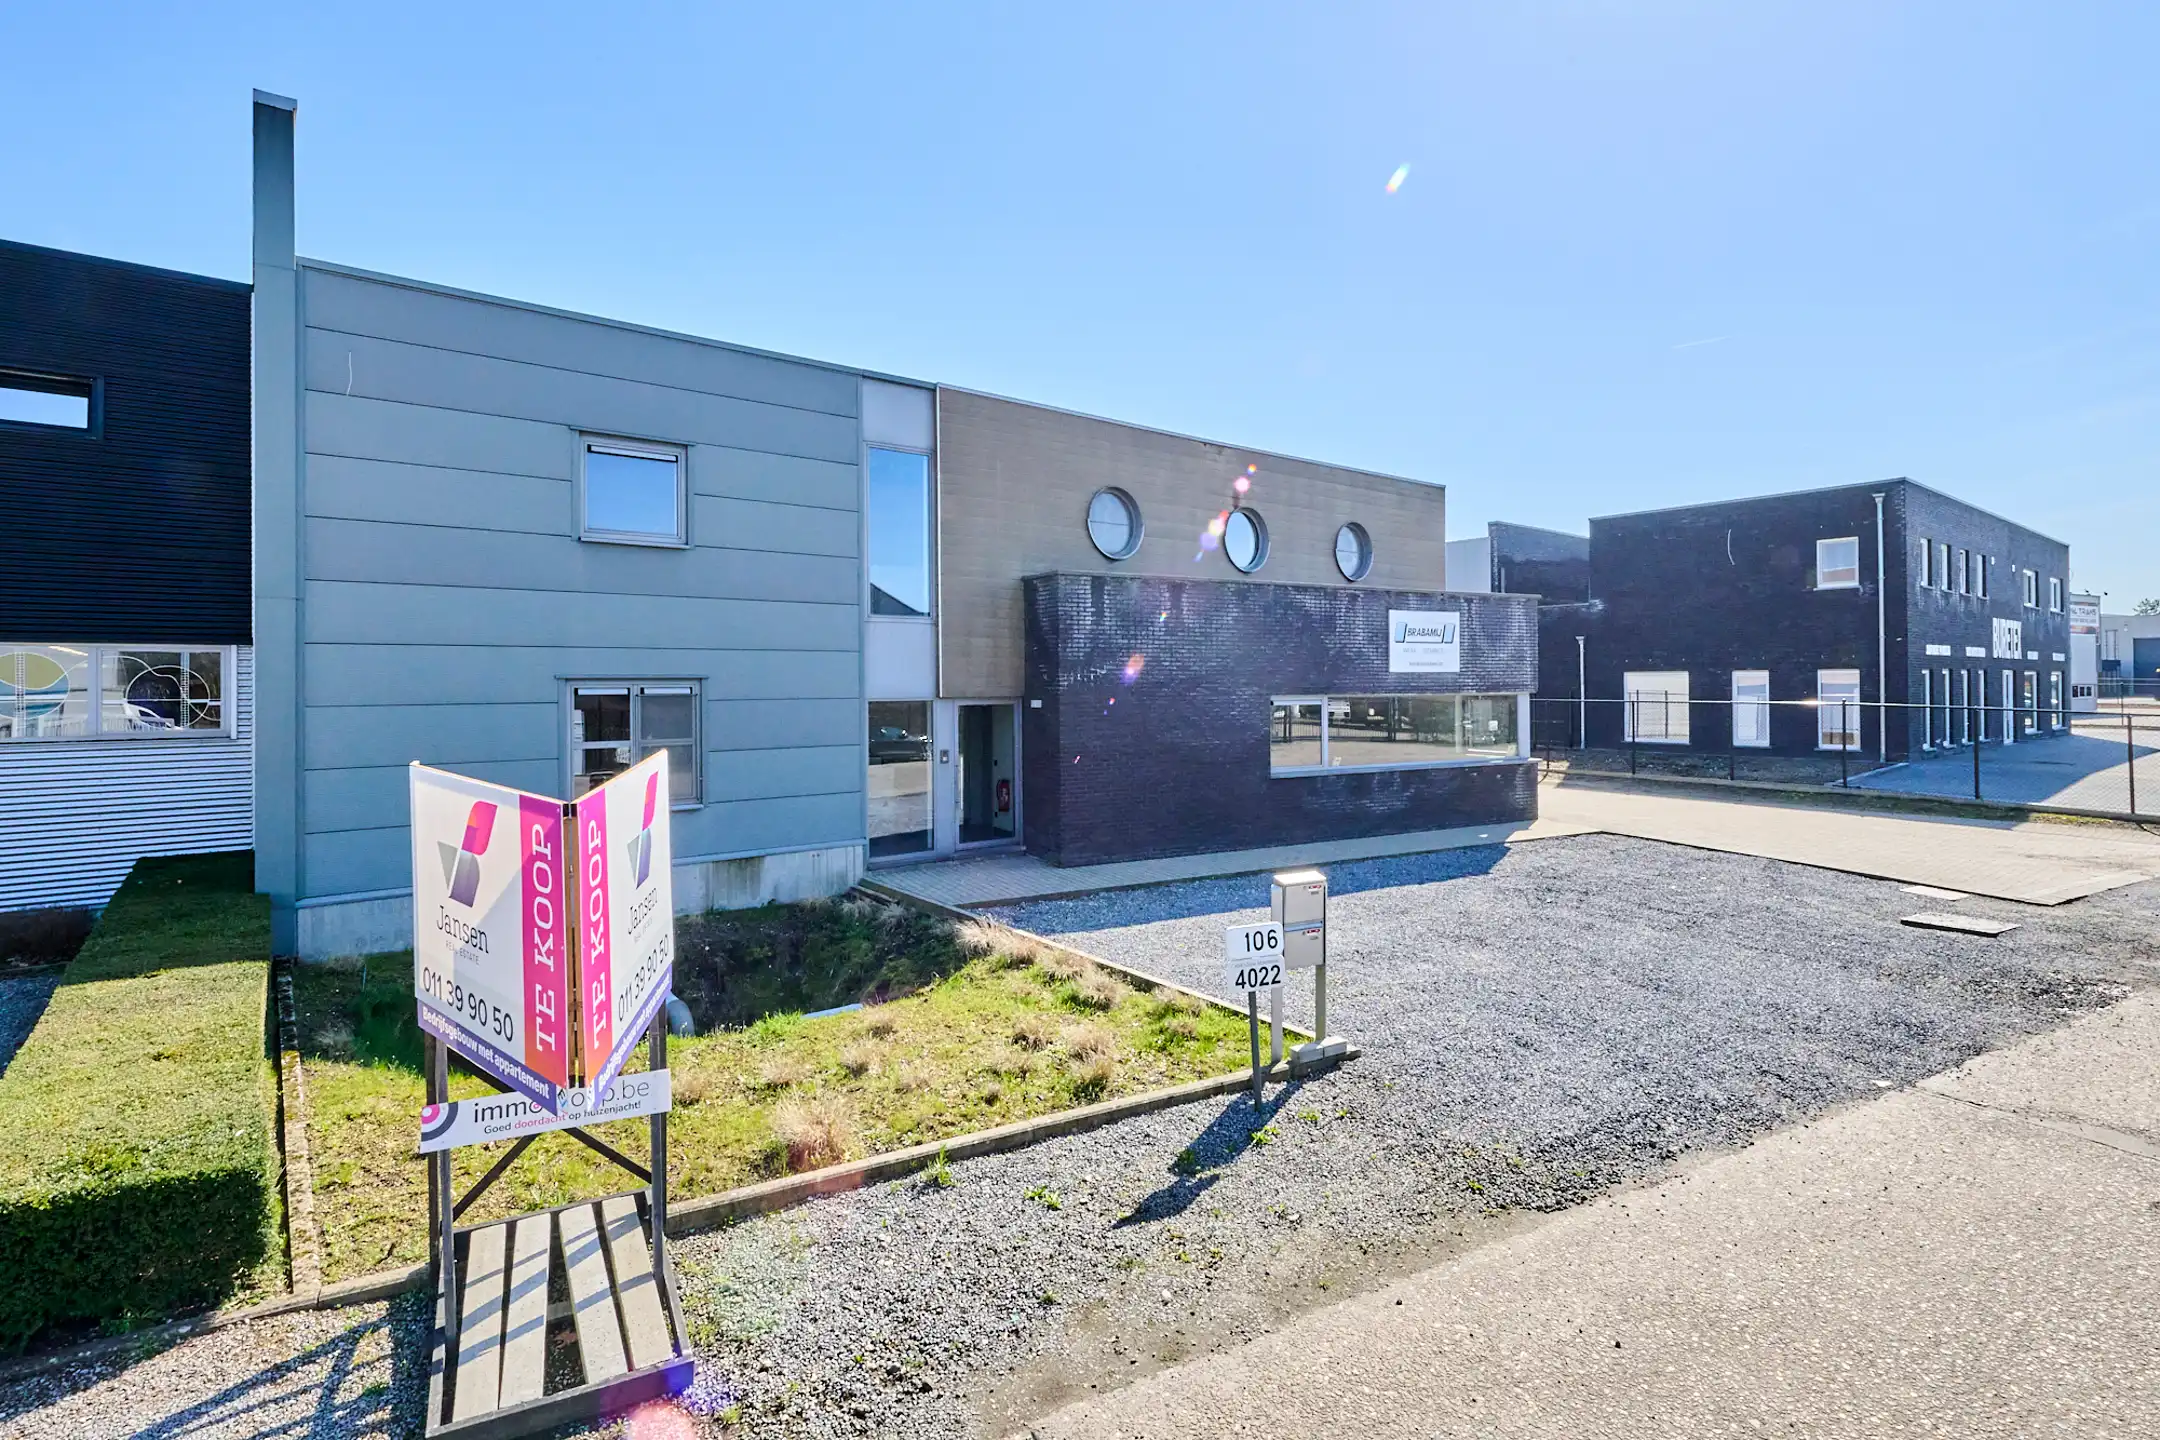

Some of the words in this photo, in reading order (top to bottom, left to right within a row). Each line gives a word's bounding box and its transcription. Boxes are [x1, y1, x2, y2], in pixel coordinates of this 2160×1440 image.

[531, 823, 555, 972] KOOP
[588, 819, 605, 965] KOOP
[628, 887, 658, 935] Jansen
[436, 904, 489, 954] Jansen
[1244, 929, 1278, 953] 106
[423, 966, 443, 1001] 011
[446, 980, 463, 1012] 39
[468, 992, 487, 1027] 90
[493, 1006, 513, 1042] 50
[591, 972, 607, 1050] TE
[618, 982, 633, 1022] 011
[635, 965, 646, 1000] 39
[647, 949, 658, 982] 90
[659, 933, 669, 964] 50
[1235, 964, 1281, 989] 4022
[422, 1006, 478, 1053] Bedrijfsgebouw
[478, 1044, 494, 1064] met
[494, 1053, 550, 1100] appartement
[535, 983, 556, 1052] TE
[483, 1123, 512, 1135] Goed
[514, 1112, 567, 1131] doordacht
[568, 1111, 582, 1122] op
[583, 1100, 642, 1119] huizenjacht!
